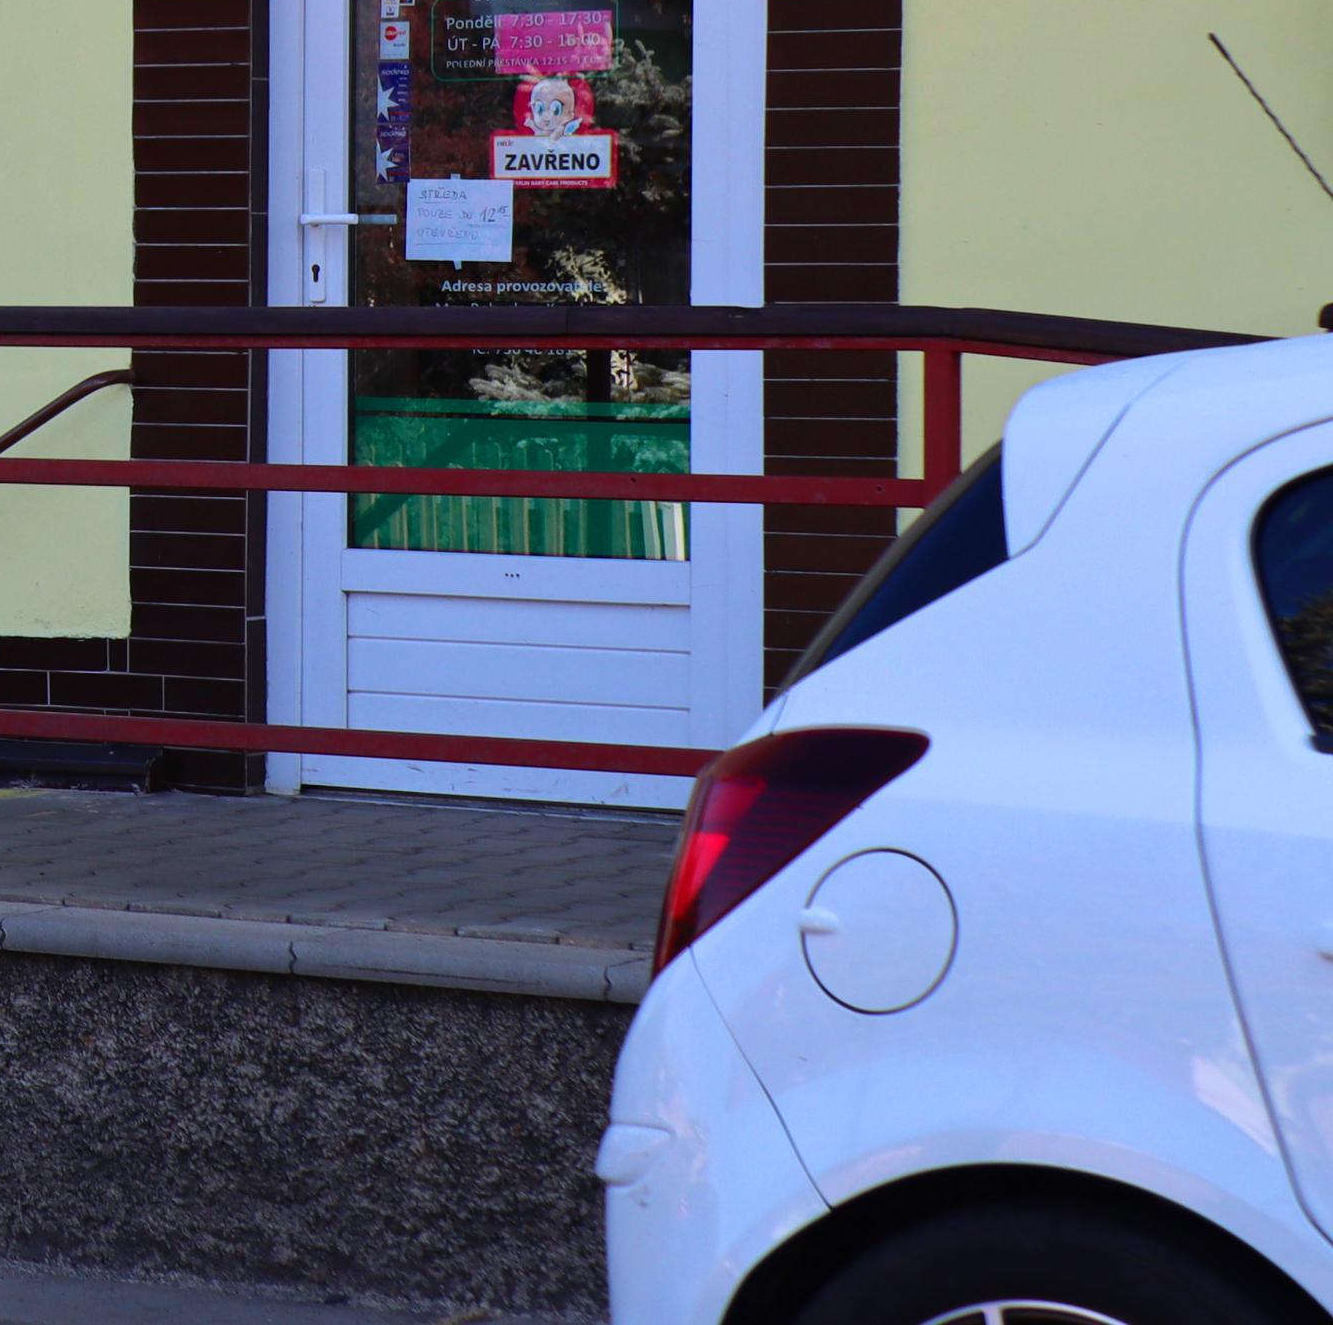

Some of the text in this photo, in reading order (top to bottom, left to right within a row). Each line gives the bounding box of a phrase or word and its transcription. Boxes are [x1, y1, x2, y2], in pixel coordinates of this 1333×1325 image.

[510, 13, 544, 27] 7:30
[559, 11, 602, 26] 17:30
[447, 35, 468, 51] ÚT
[509, 35, 543, 49] 7:30
[504, 149, 600, 171] ZAVŘENO
[419, 187, 467, 200] STŘEDA
[441, 279, 492, 292] Adresa
